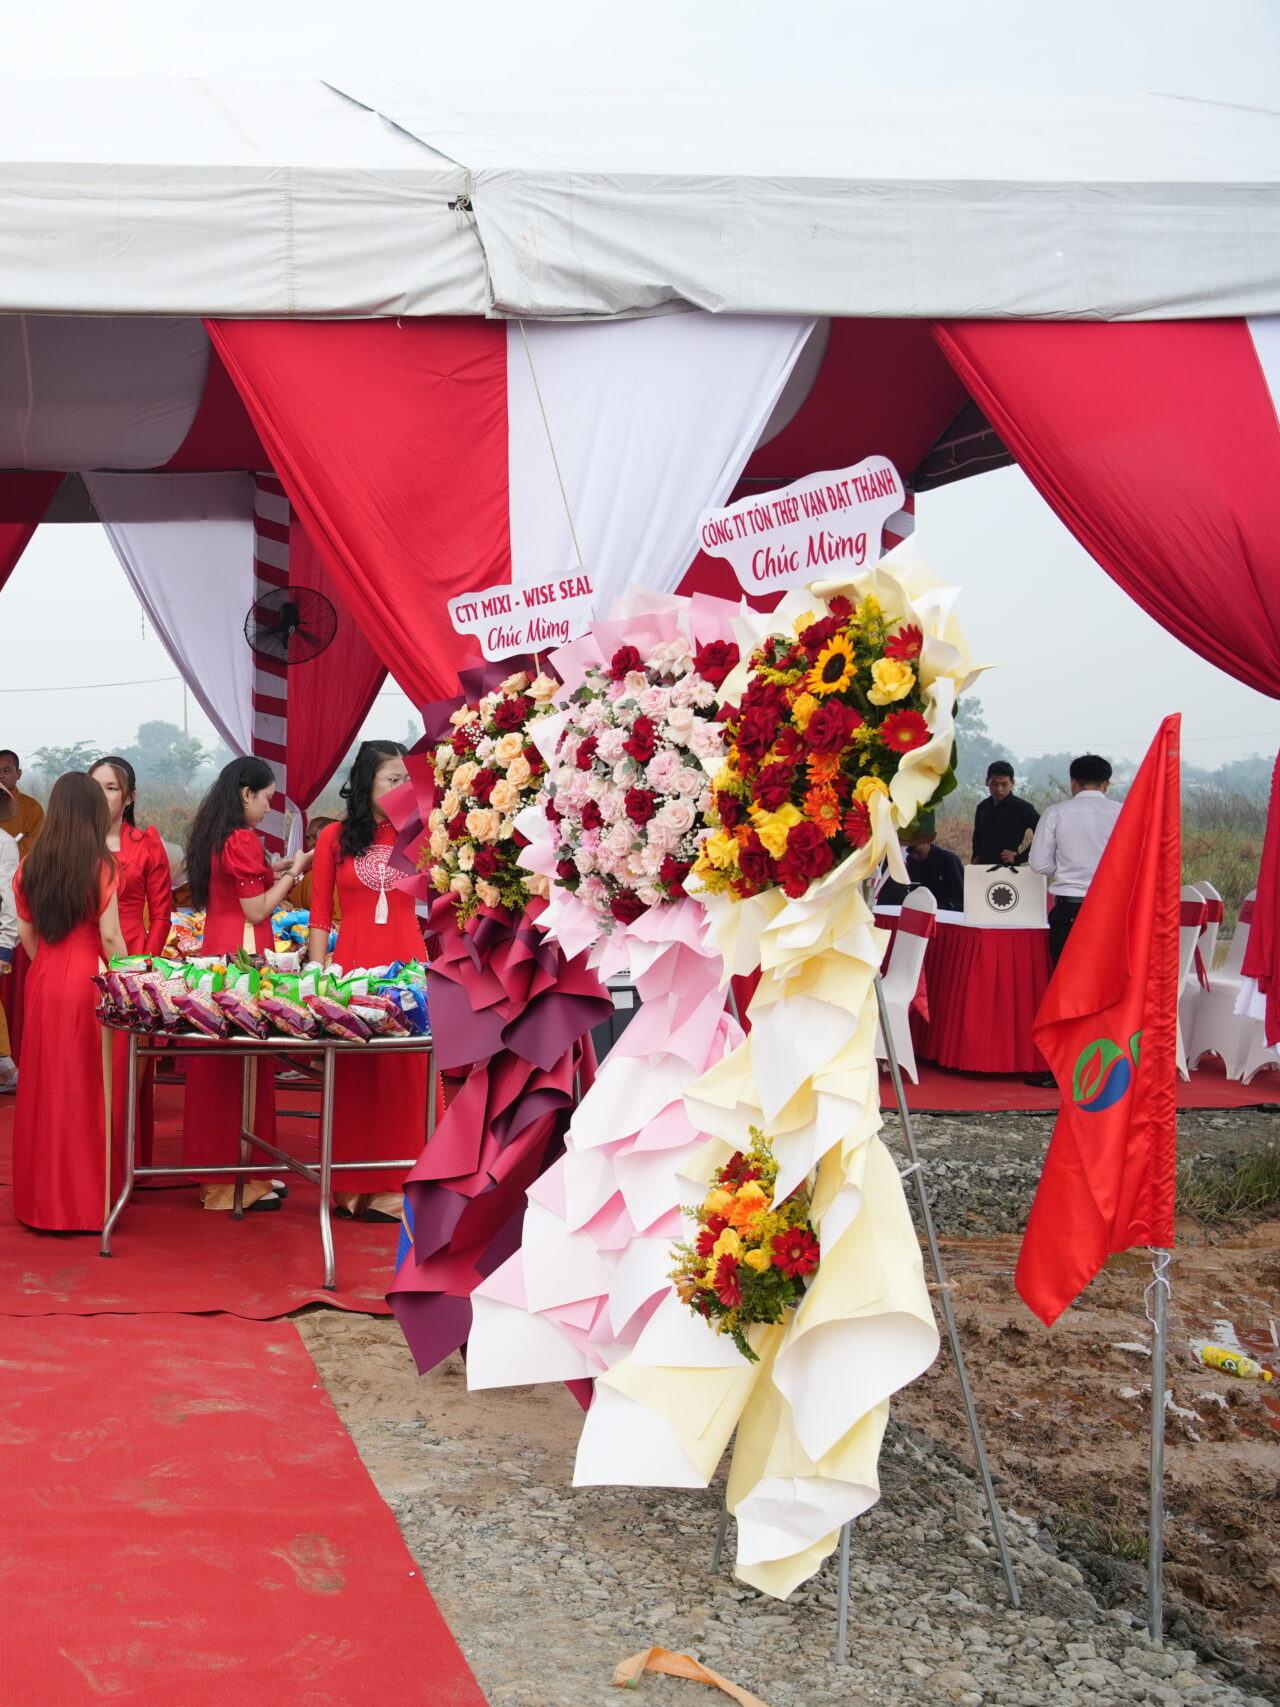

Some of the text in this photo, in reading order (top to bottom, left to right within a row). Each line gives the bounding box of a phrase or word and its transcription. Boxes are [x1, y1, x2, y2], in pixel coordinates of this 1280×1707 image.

[701, 466, 898, 549] CÔNG TY TÔN THÉP VẠN ĐẠT THÀNH
[751, 530, 868, 582] Chúc Mừng
[454, 601, 479, 624] CTY
[480, 593, 513, 619] MIXI
[522, 582, 557, 608] WISE
[558, 575, 594, 600] SEAL
[487, 617, 570, 652] Chúc Mừng
